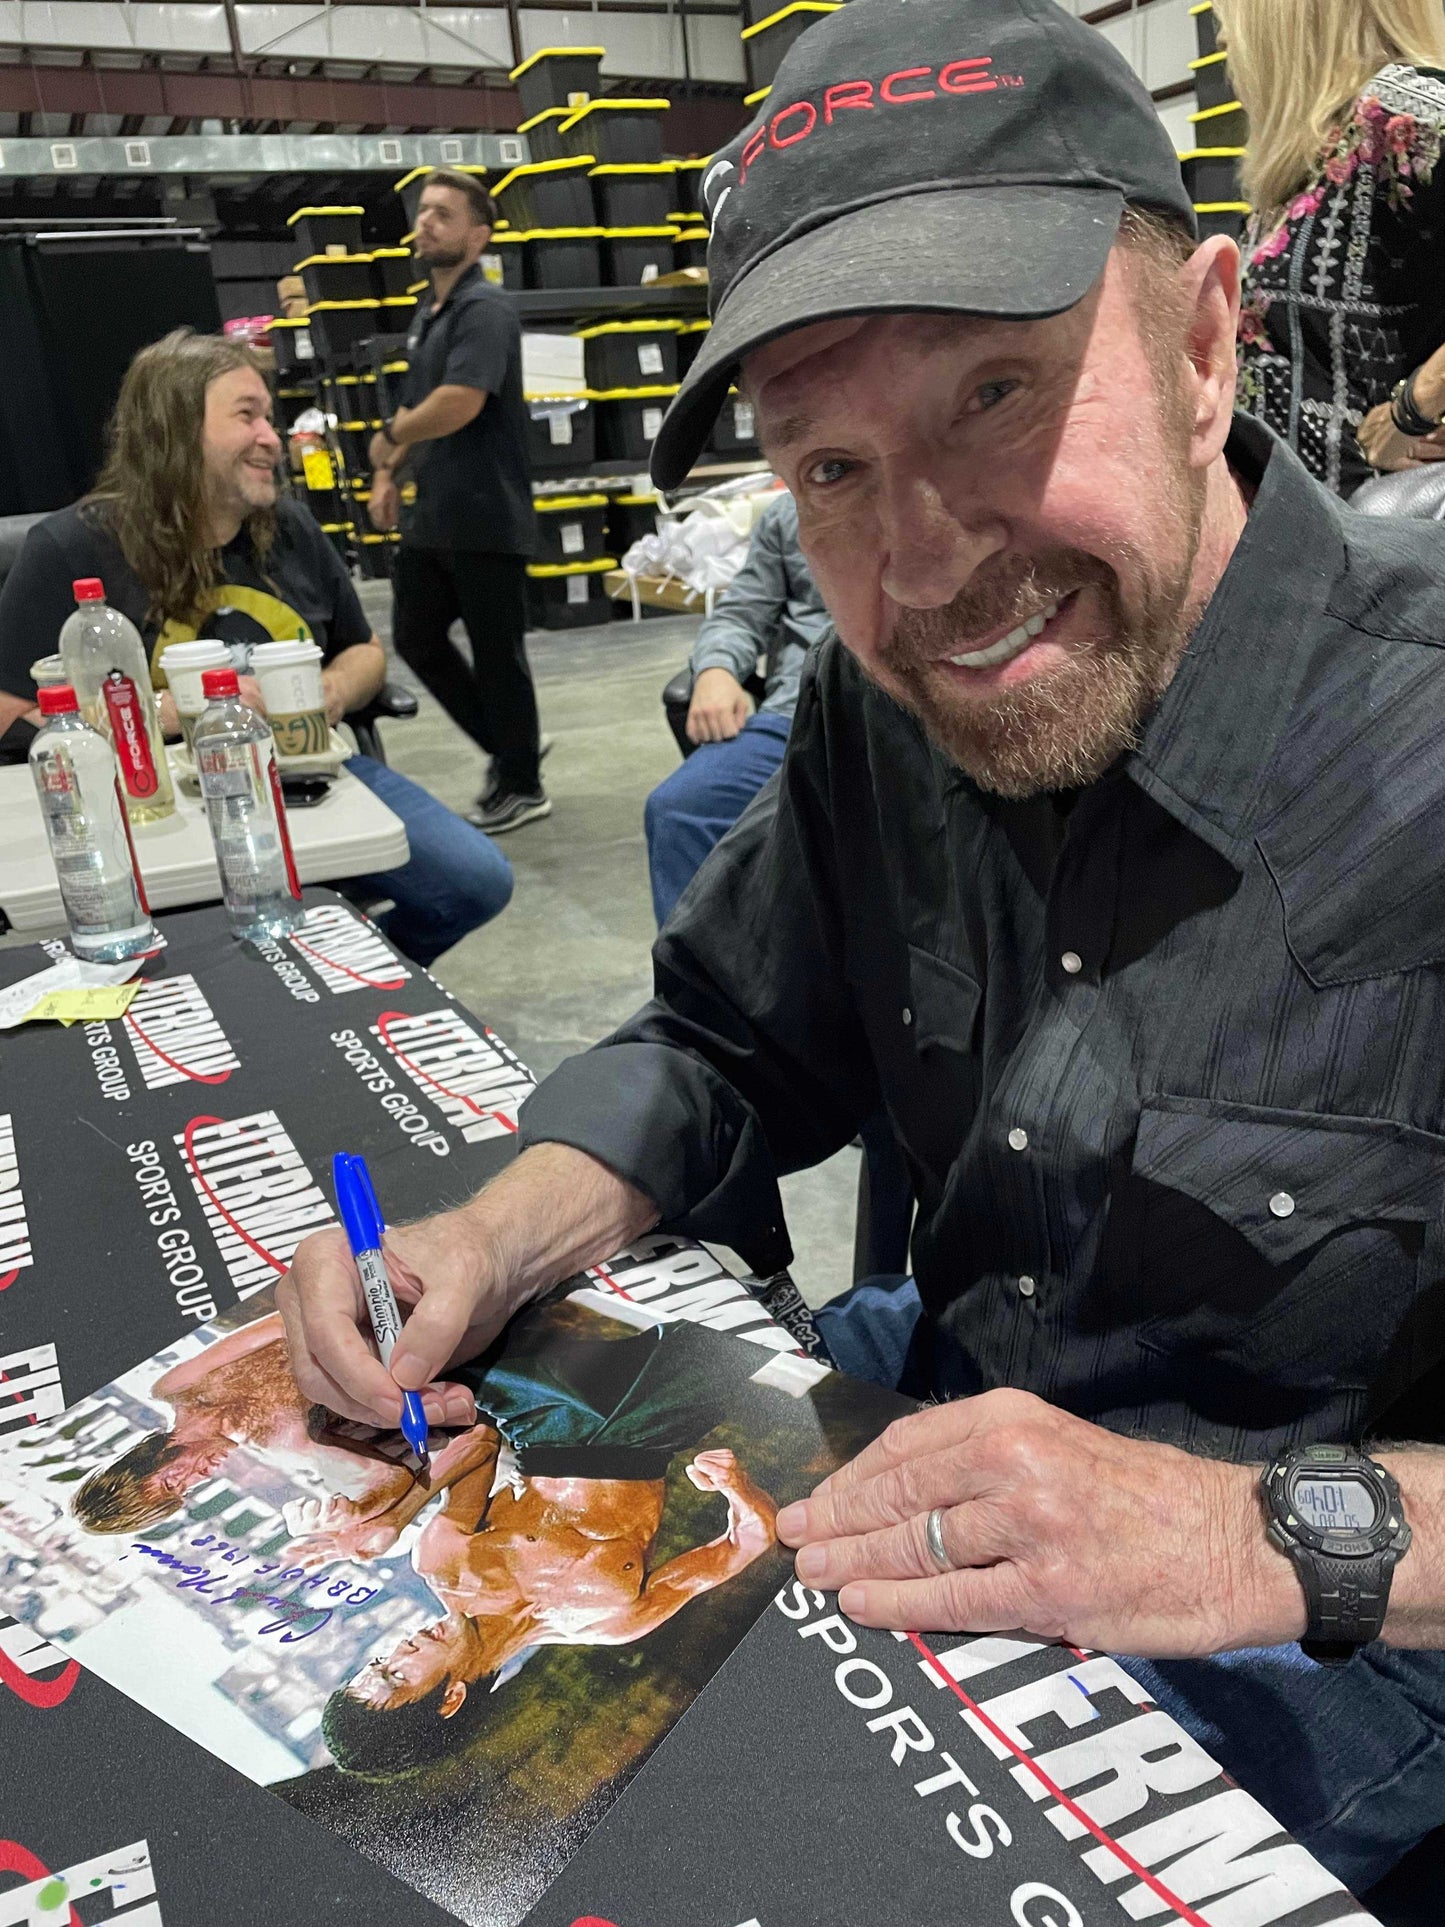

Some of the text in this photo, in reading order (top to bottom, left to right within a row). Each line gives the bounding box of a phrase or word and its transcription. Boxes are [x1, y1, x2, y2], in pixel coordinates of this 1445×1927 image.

[738, 56, 998, 187] FORCE
[120, 705, 144, 771] FORCE
[272, 960, 321, 1003] GROUP
[91, 1046, 131, 1101] GROUP
[330, 1028, 451, 1157] SPORTS GROUP
[126, 1140, 218, 1323] SPORTS GROUP
[191, 1534, 249, 1566] 1968
[1327, 1541, 1369, 1553] SHOCK
[774, 1579, 1013, 1861] SPORTS
